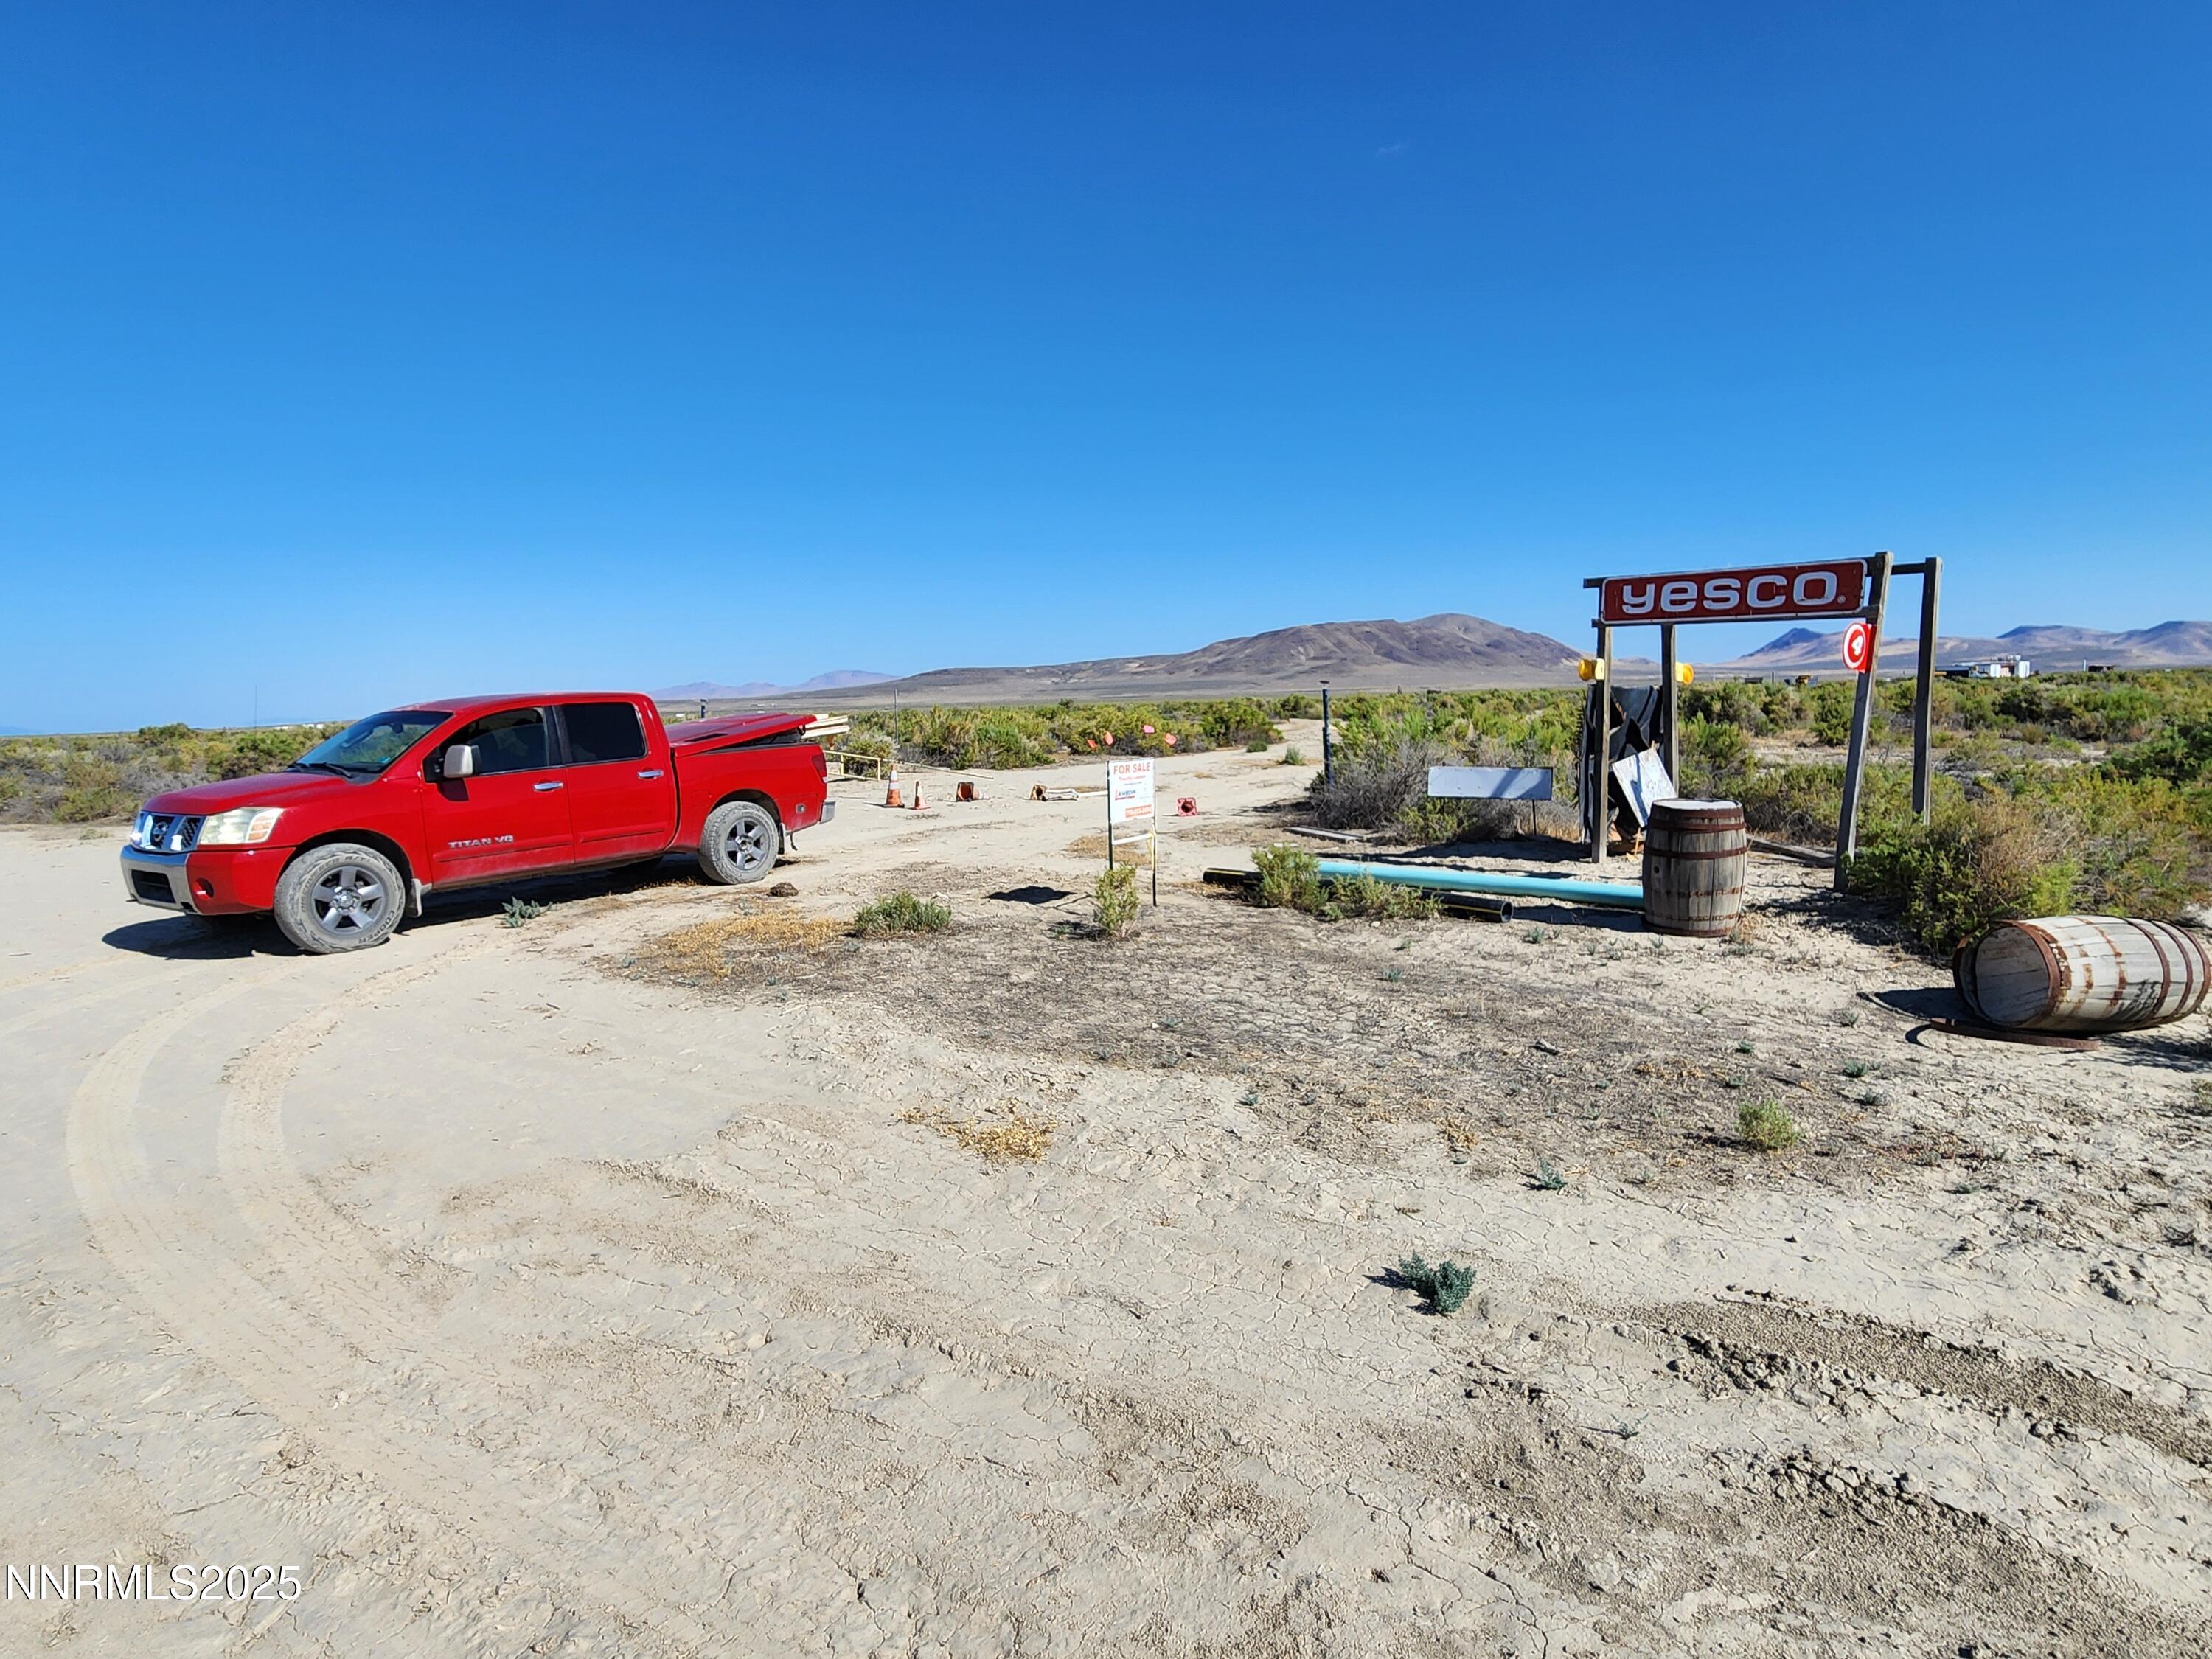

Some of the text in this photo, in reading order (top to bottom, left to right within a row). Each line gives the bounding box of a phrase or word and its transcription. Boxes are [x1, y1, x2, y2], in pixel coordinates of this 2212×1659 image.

[1621, 571, 1838, 615] yesco
[1113, 762, 1150, 775] FOR SALE
[448, 835, 515, 849] TITAN V8
[358, 910, 395, 945] COOPER
